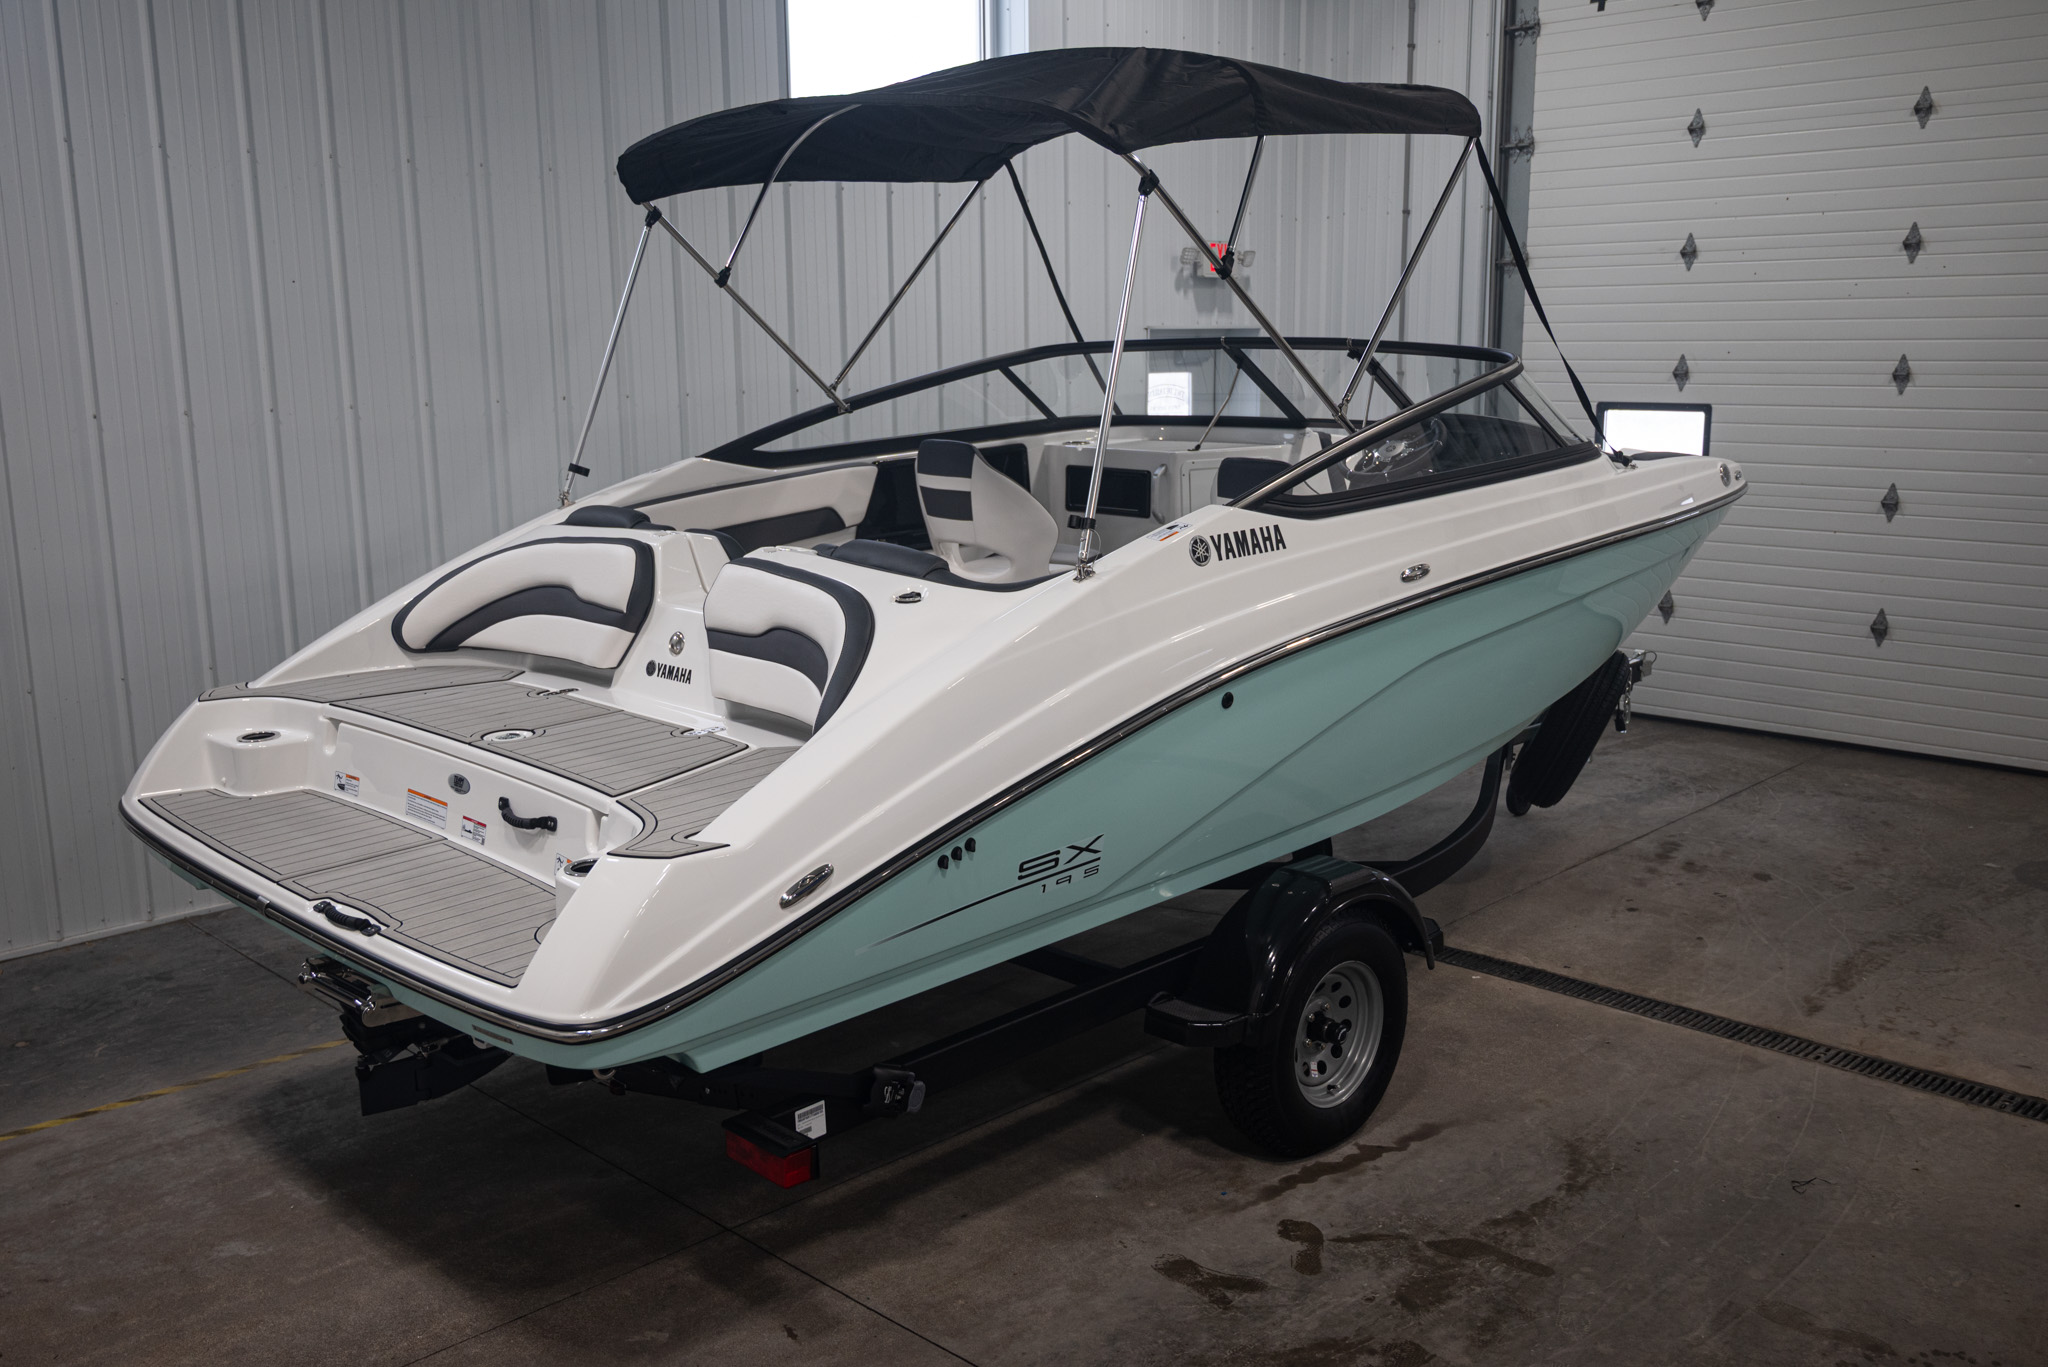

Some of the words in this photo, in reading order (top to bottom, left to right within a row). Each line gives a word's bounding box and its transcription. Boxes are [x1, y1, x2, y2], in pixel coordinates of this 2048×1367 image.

[1210, 524, 1287, 561] YAMAHA
[657, 662, 692, 684] YAMAHA
[1018, 834, 1104, 880] SX
[1041, 864, 1100, 893] 195
